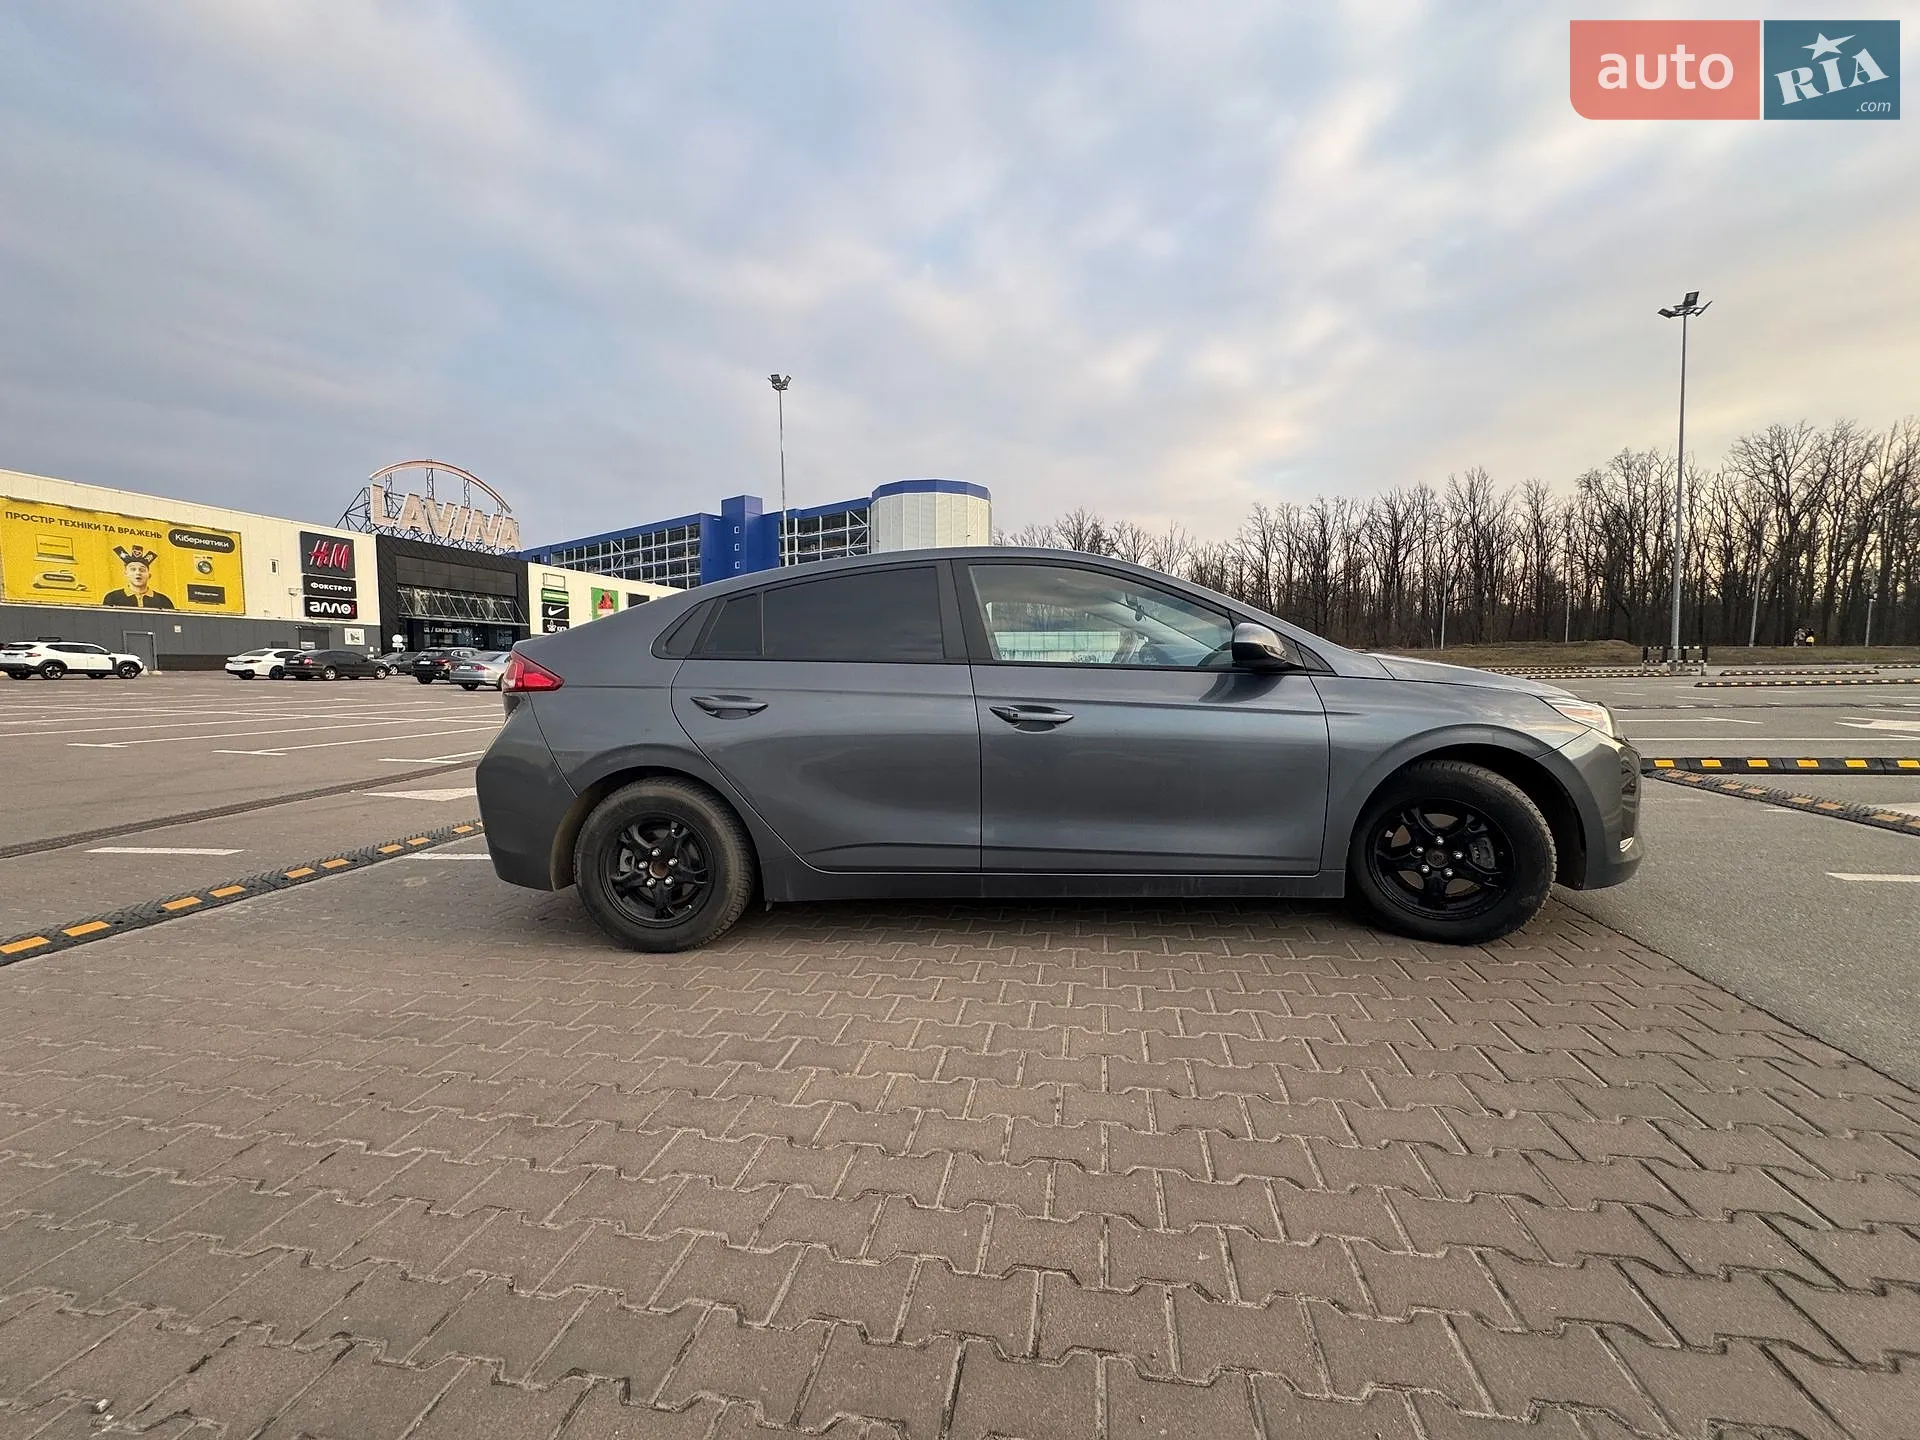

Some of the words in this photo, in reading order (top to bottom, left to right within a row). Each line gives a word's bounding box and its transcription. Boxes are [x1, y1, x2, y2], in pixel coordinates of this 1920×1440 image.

[5, 511, 55, 525] ПРОСТІР
[58, 518, 102, 532] ТЕХНІКИ
[103, 524, 116, 533] ТА
[118, 527, 163, 540] ВРАЖЕНЬ
[370, 484, 521, 551] LAVINA
[174, 533, 229, 549] Кібернетики
[308, 539, 350, 572] H&M
[310, 581, 353, 593] ФОКСТРОТ
